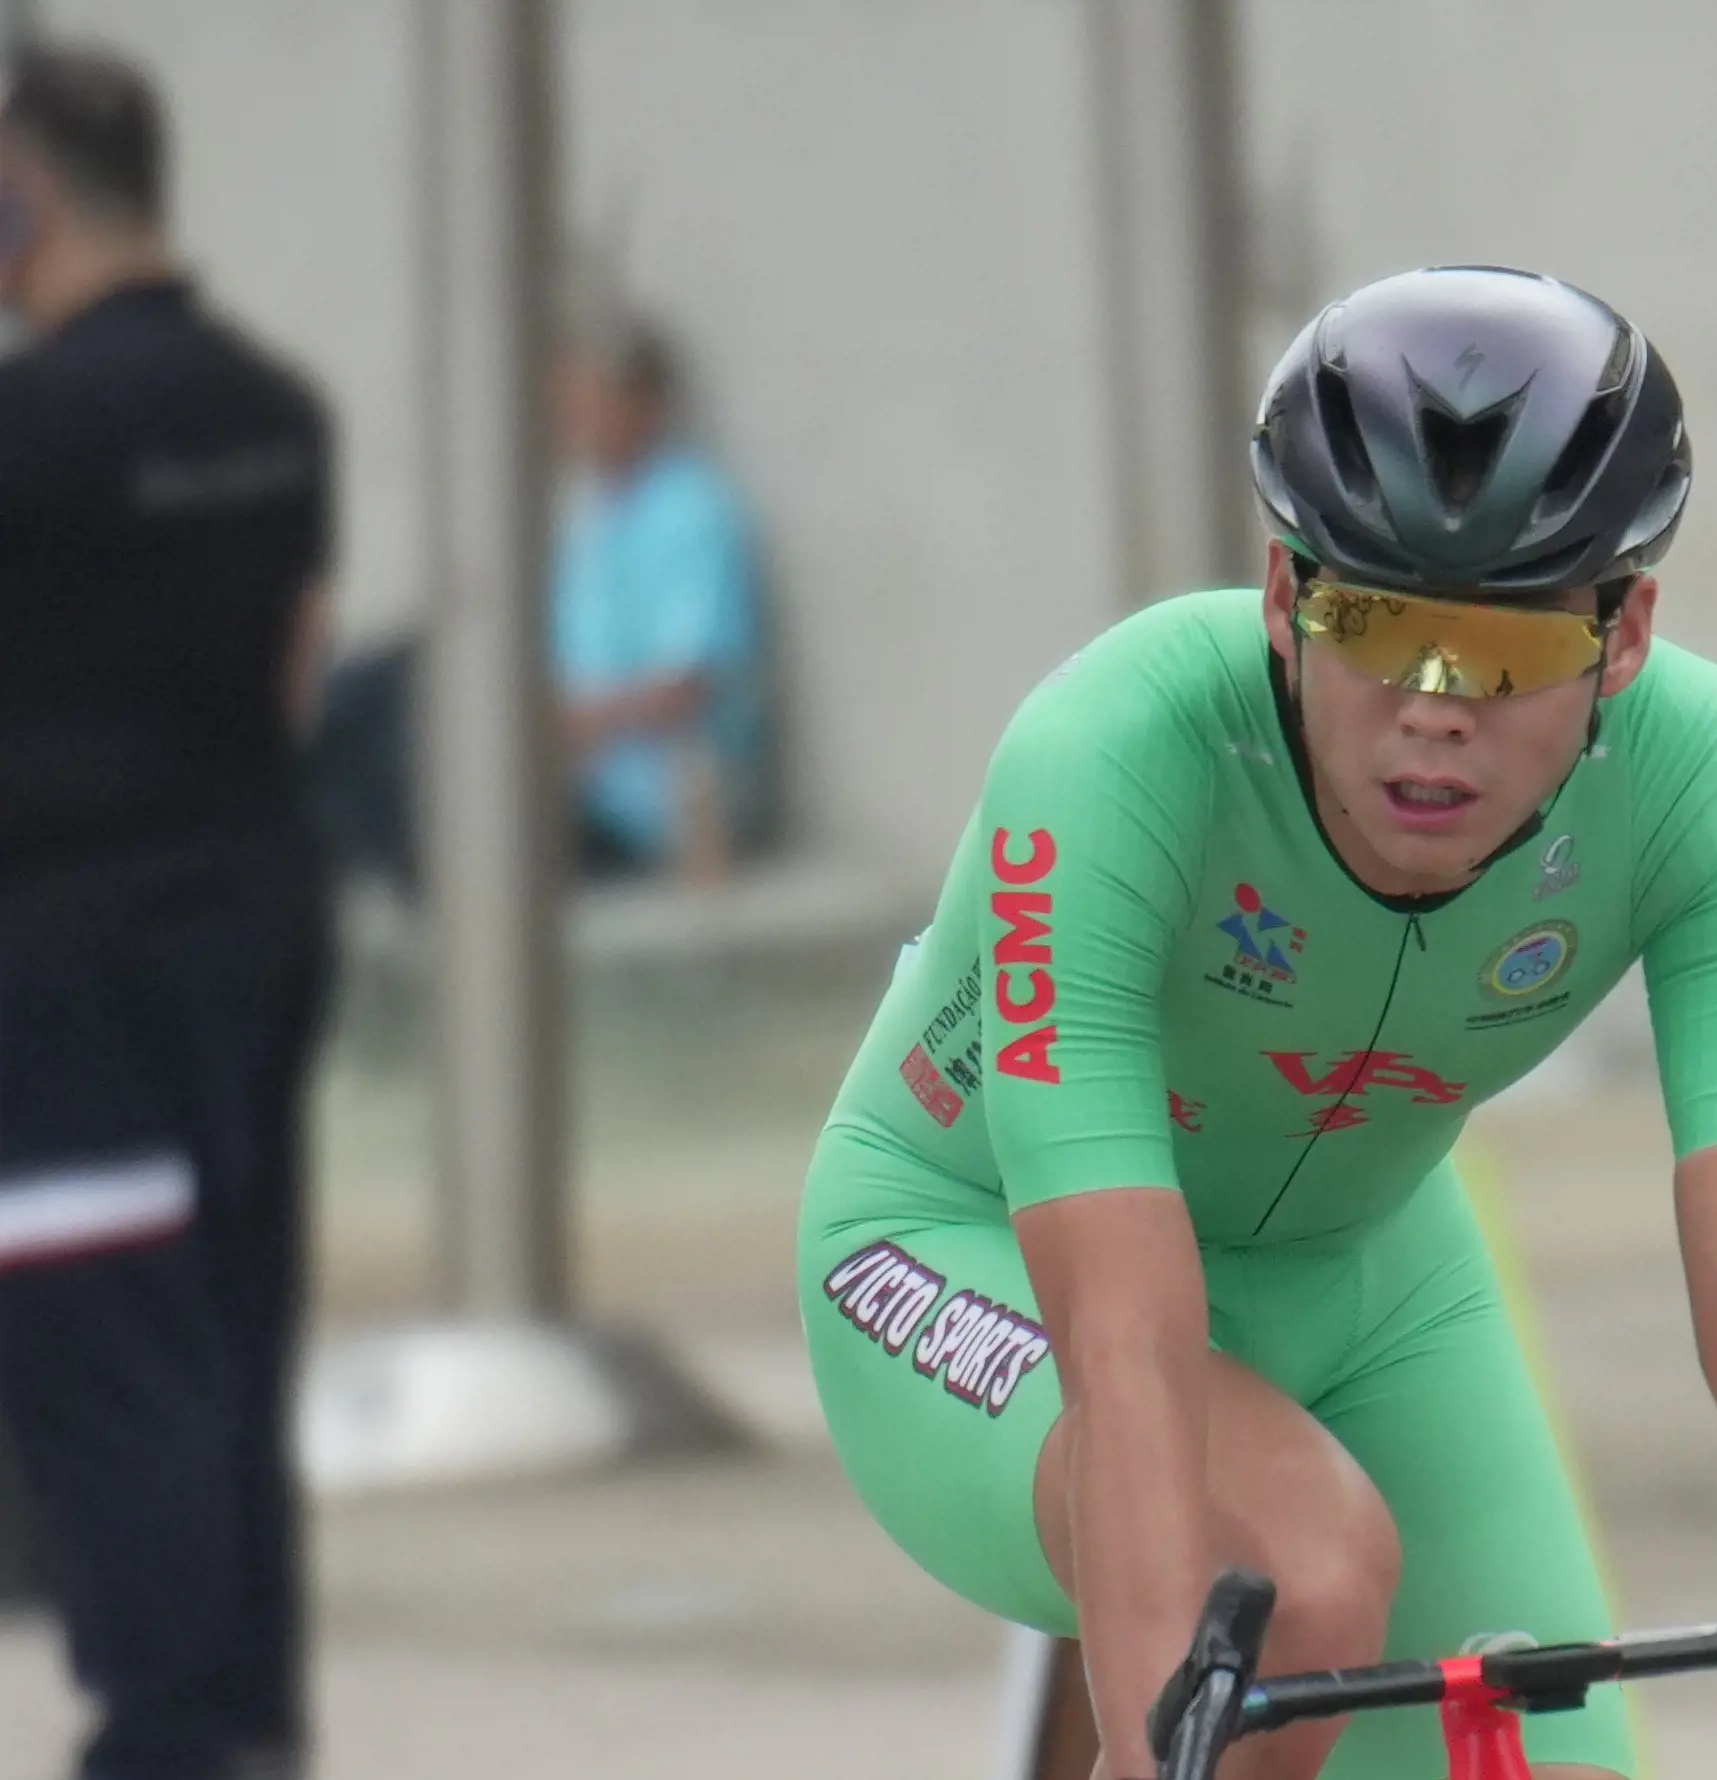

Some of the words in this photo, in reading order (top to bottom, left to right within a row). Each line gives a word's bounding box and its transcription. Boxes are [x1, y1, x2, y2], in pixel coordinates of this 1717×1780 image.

[990, 826, 1061, 1084] ACMC
[826, 1245, 943, 1353] VICTO
[914, 1293, 1049, 1412] SPORTS
